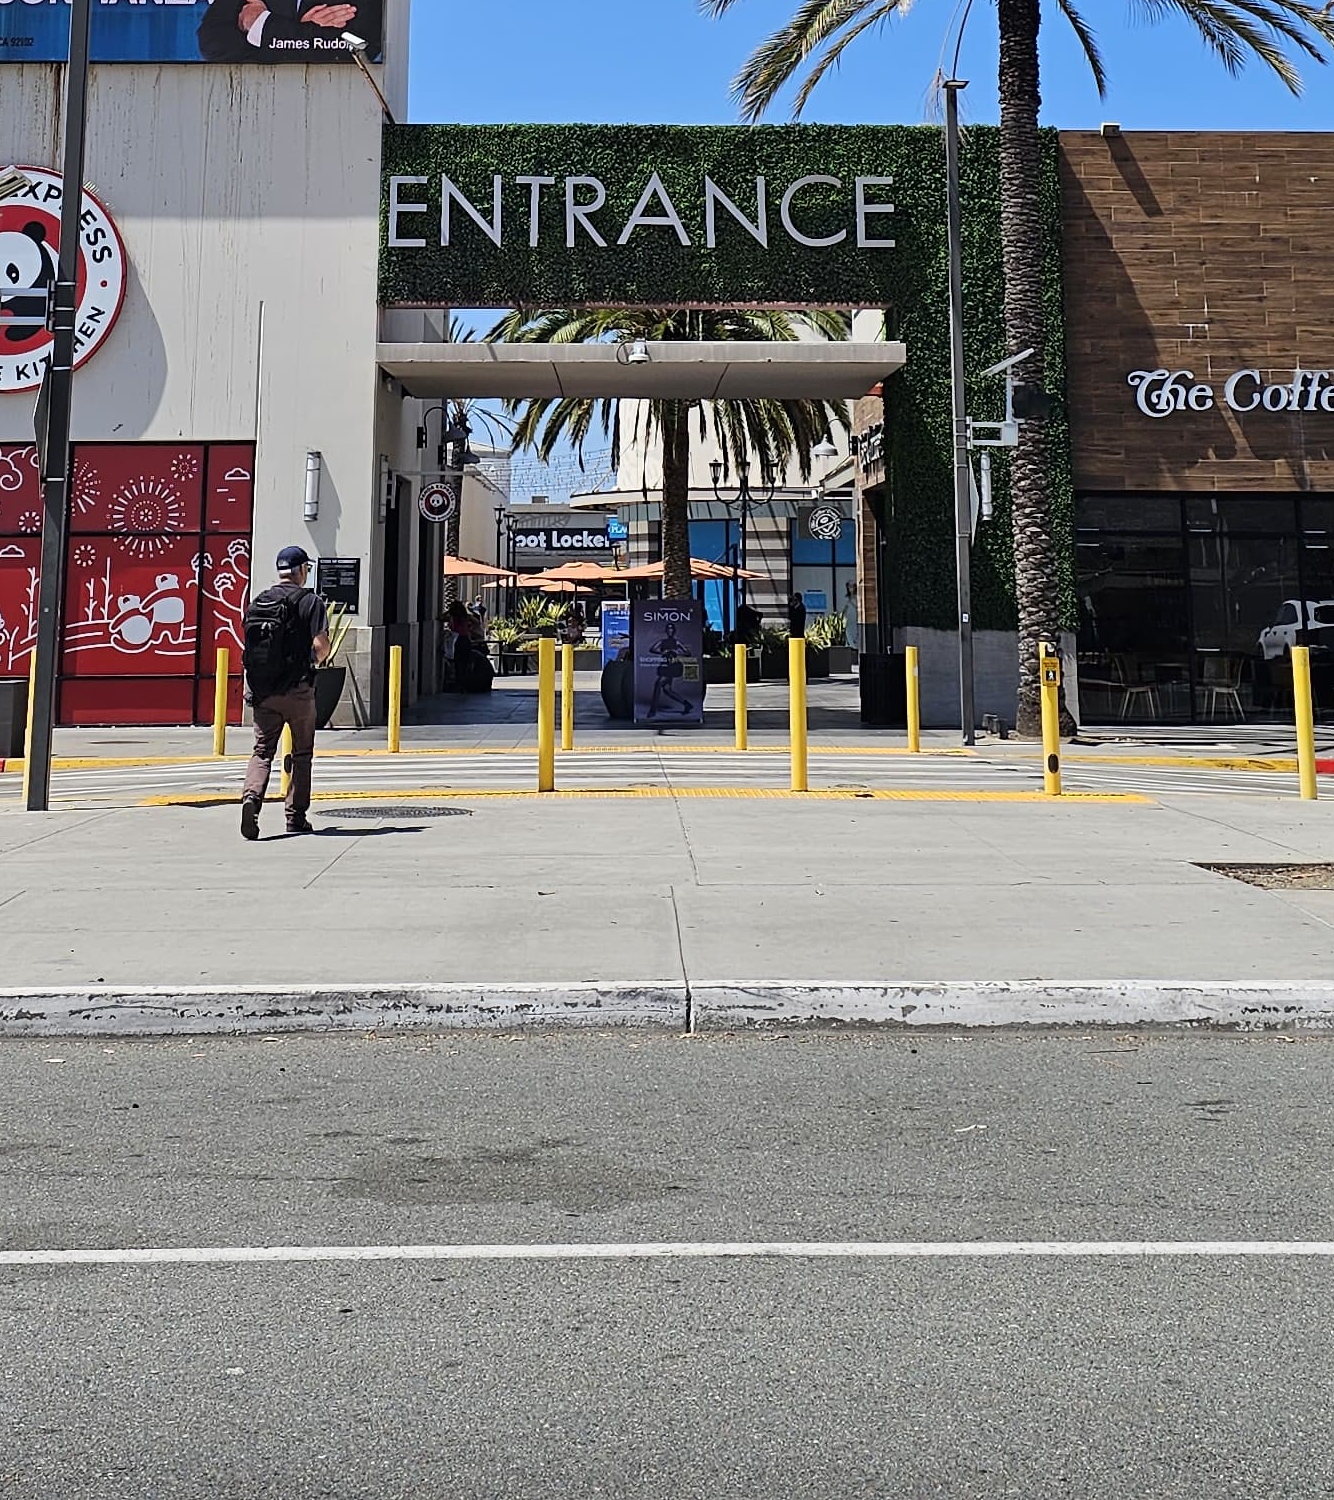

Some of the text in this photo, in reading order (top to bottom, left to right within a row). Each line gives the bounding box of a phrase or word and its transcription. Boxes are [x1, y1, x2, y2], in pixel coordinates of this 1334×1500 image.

[268, 38, 310, 50] James
[387, 171, 897, 249] ENTRANCE
[1127, 368, 1214, 418] The
[514, 531, 547, 548] oot
[643, 611, 691, 622] SIMON
